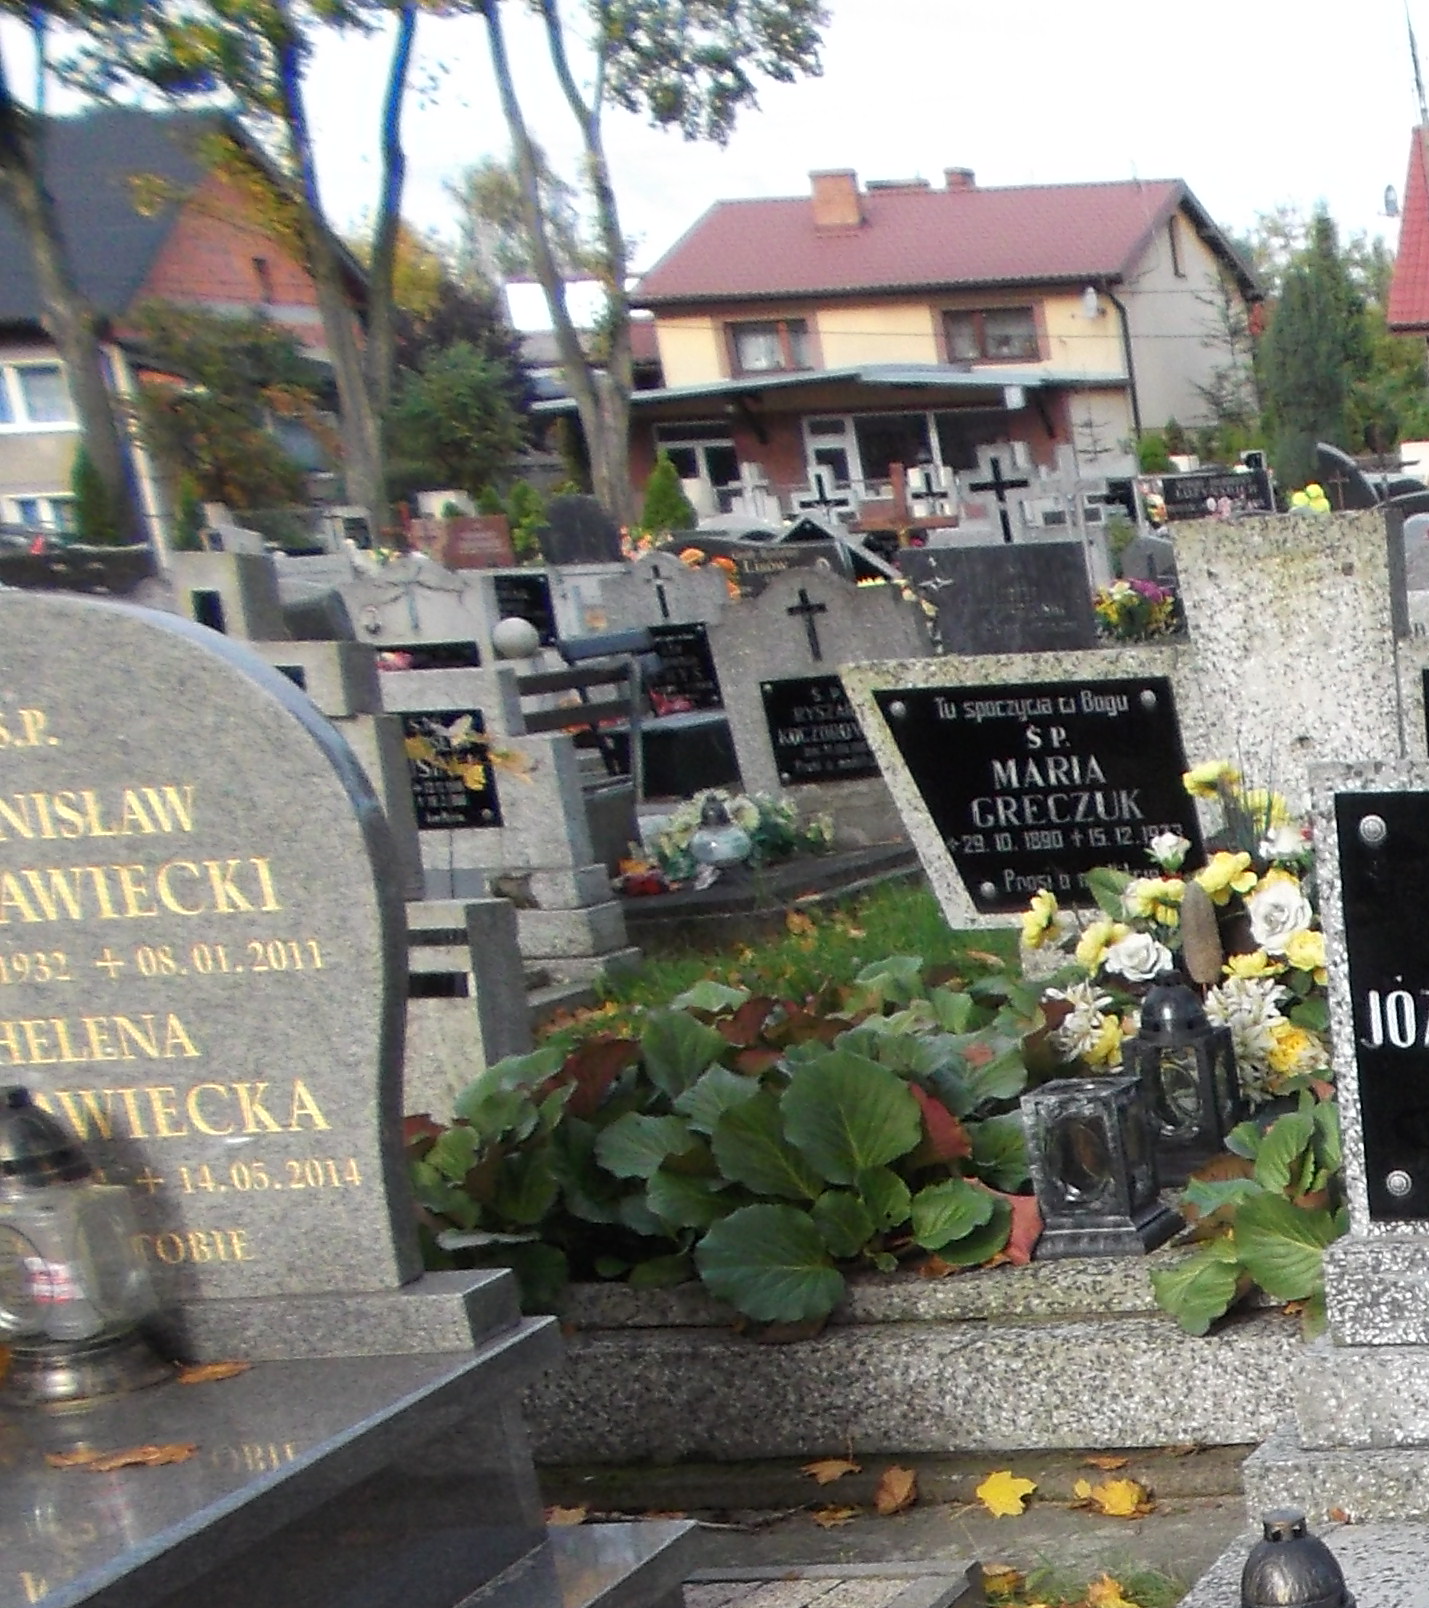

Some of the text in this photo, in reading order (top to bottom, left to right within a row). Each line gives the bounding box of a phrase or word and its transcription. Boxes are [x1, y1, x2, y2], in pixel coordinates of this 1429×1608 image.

[933, 696, 957, 720] Tu
[1080, 689, 1129, 718] Bogu
[991, 753, 1107, 791] MARIA
[970, 788, 1146, 829] GRECZUK
[136, 938, 325, 978] 08.01.2011
[31, 1076, 333, 1142] WIECKA
[178, 1158, 363, 1194] 14.05.2014
